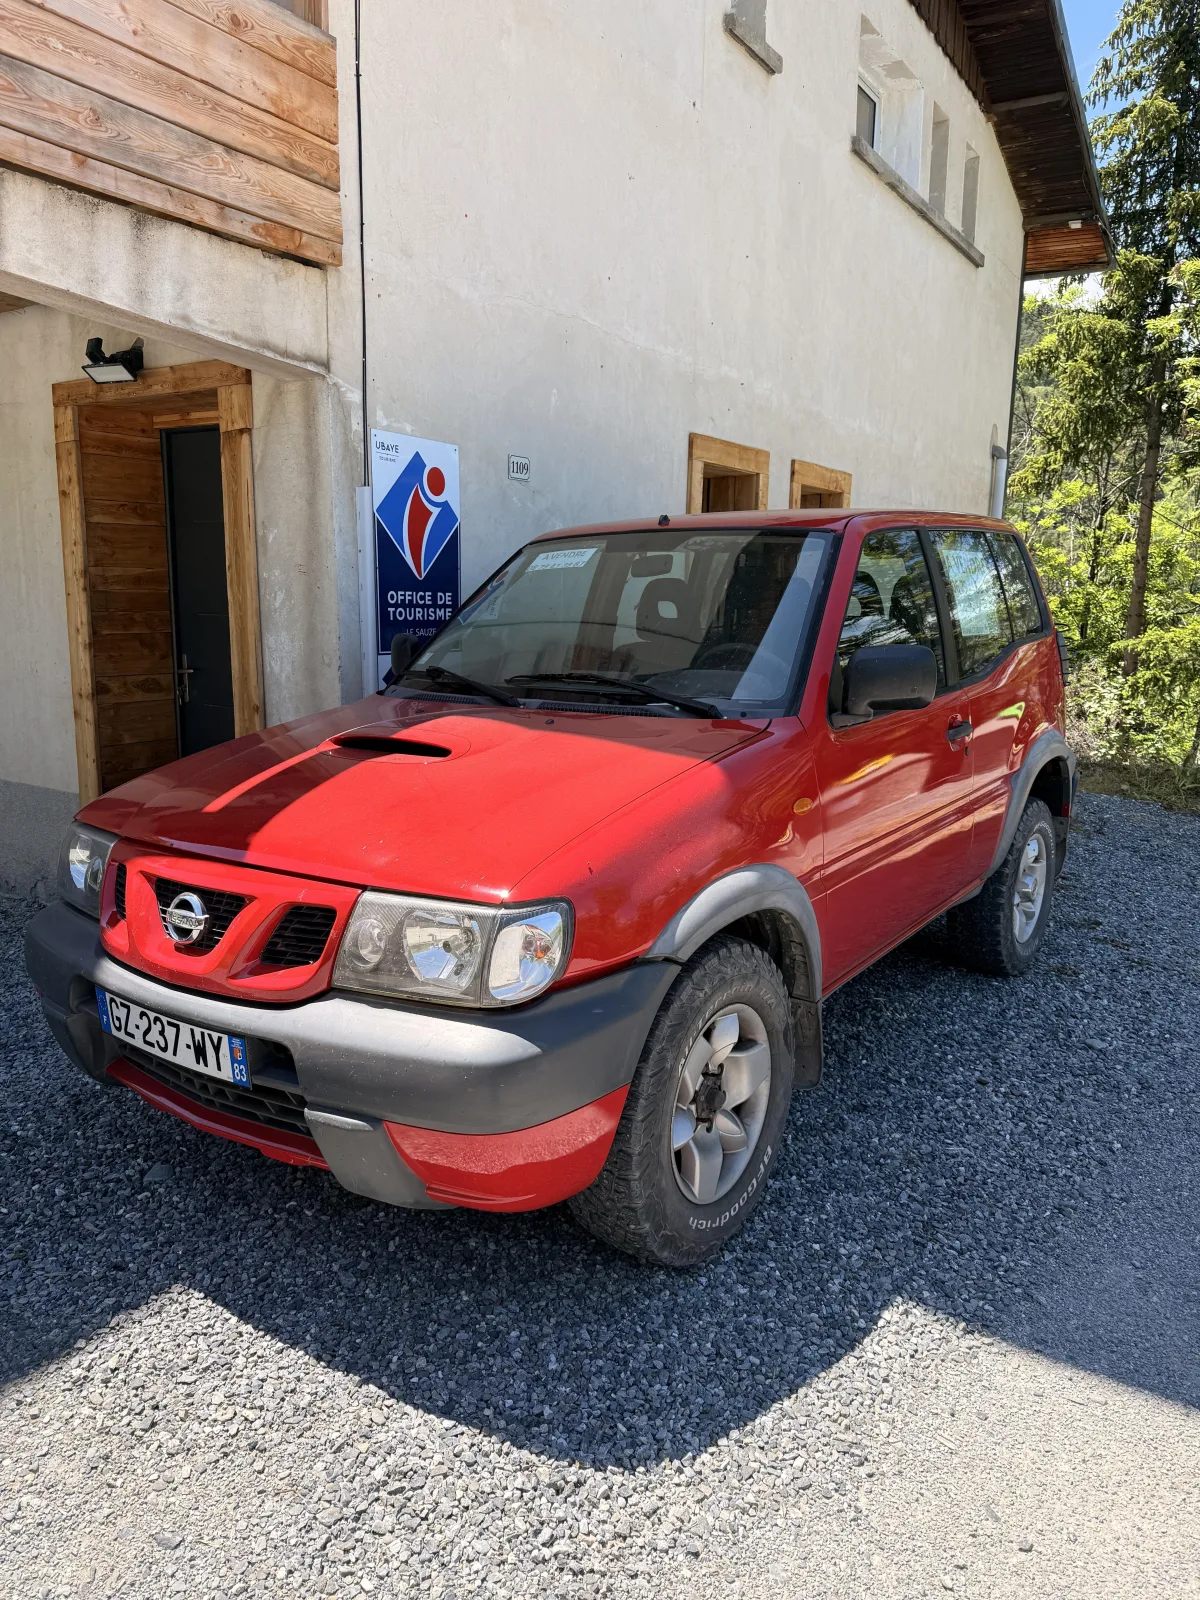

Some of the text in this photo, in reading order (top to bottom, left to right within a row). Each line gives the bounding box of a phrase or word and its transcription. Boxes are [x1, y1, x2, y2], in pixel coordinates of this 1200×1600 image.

[375, 440, 400, 454] UBAYE
[511, 460, 529, 476] 1109
[551, 550, 588, 560] VENDRE
[387, 590, 453, 605] OFFICE DE
[387, 607, 453, 621] TOURISME
[109, 996, 223, 1073] GZ-237-WY
[233, 1062, 247, 1082] 83
[688, 1144, 773, 1232] BFGoodrich
